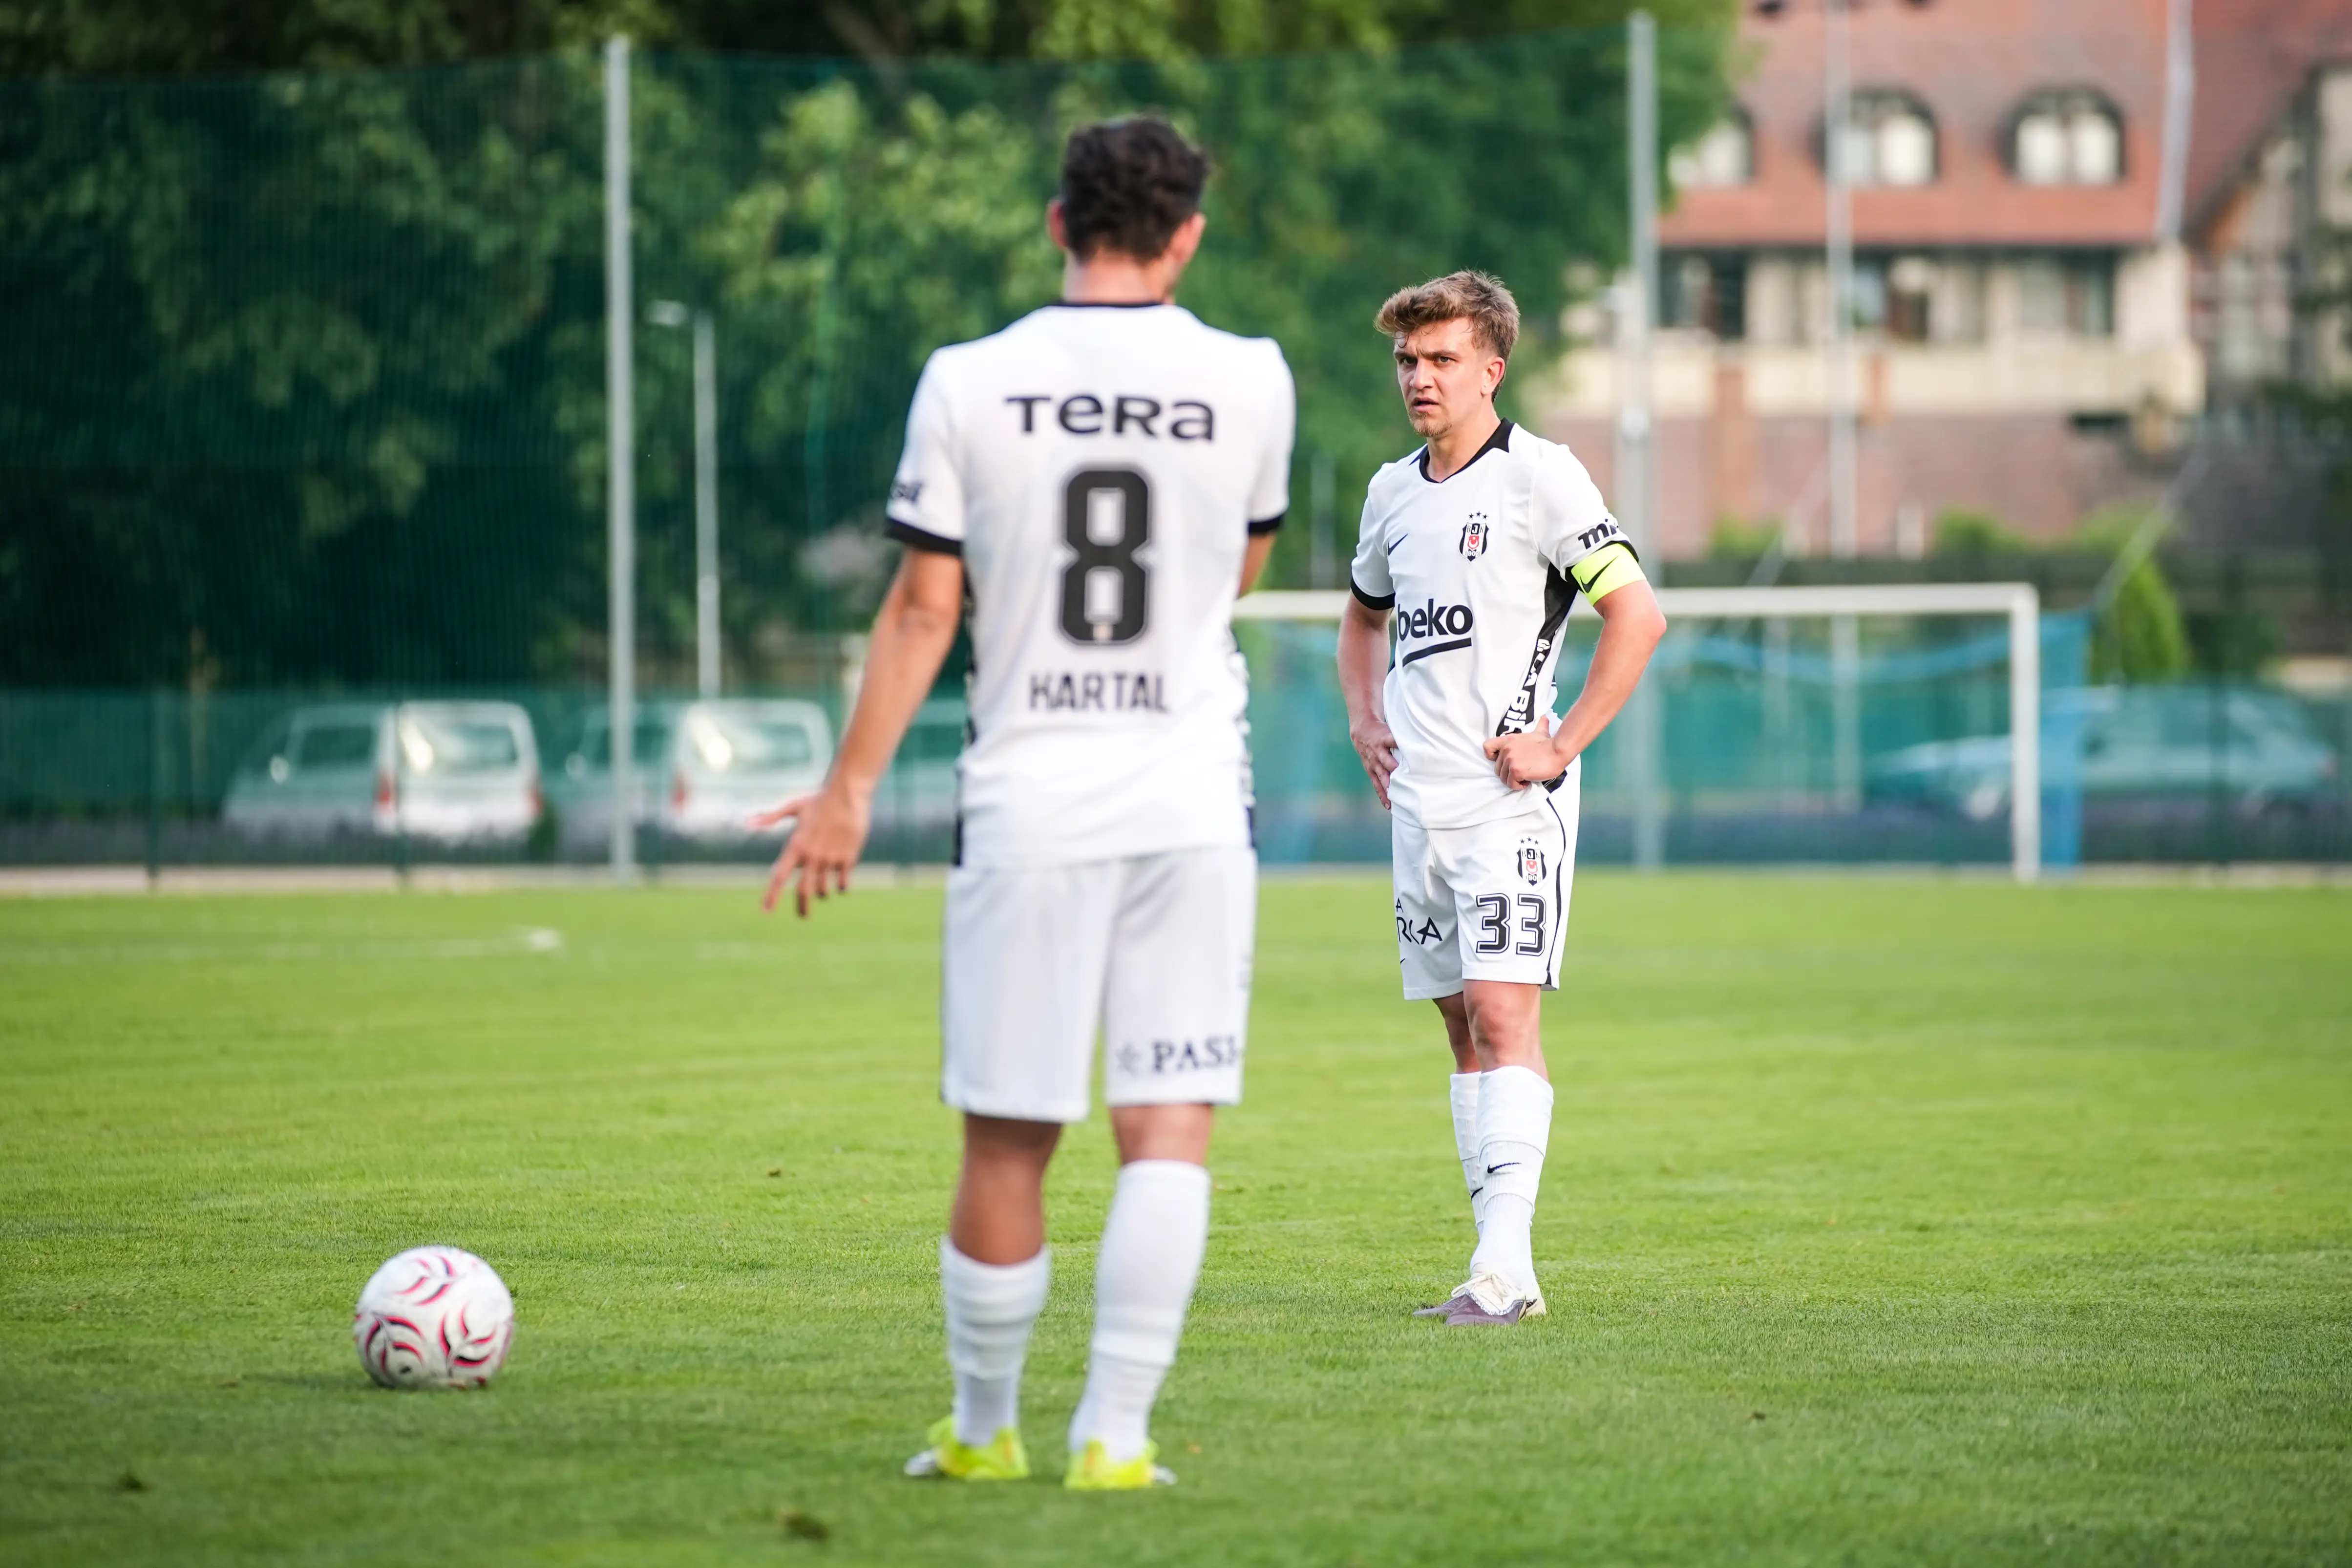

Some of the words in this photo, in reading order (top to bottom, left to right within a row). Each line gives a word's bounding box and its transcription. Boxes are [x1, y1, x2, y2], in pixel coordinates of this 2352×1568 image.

[1057, 465, 1151, 646] 8
[1398, 598, 1473, 641] beko
[1029, 671, 1170, 712] KARTAL
[1476, 893, 1547, 957] 33
